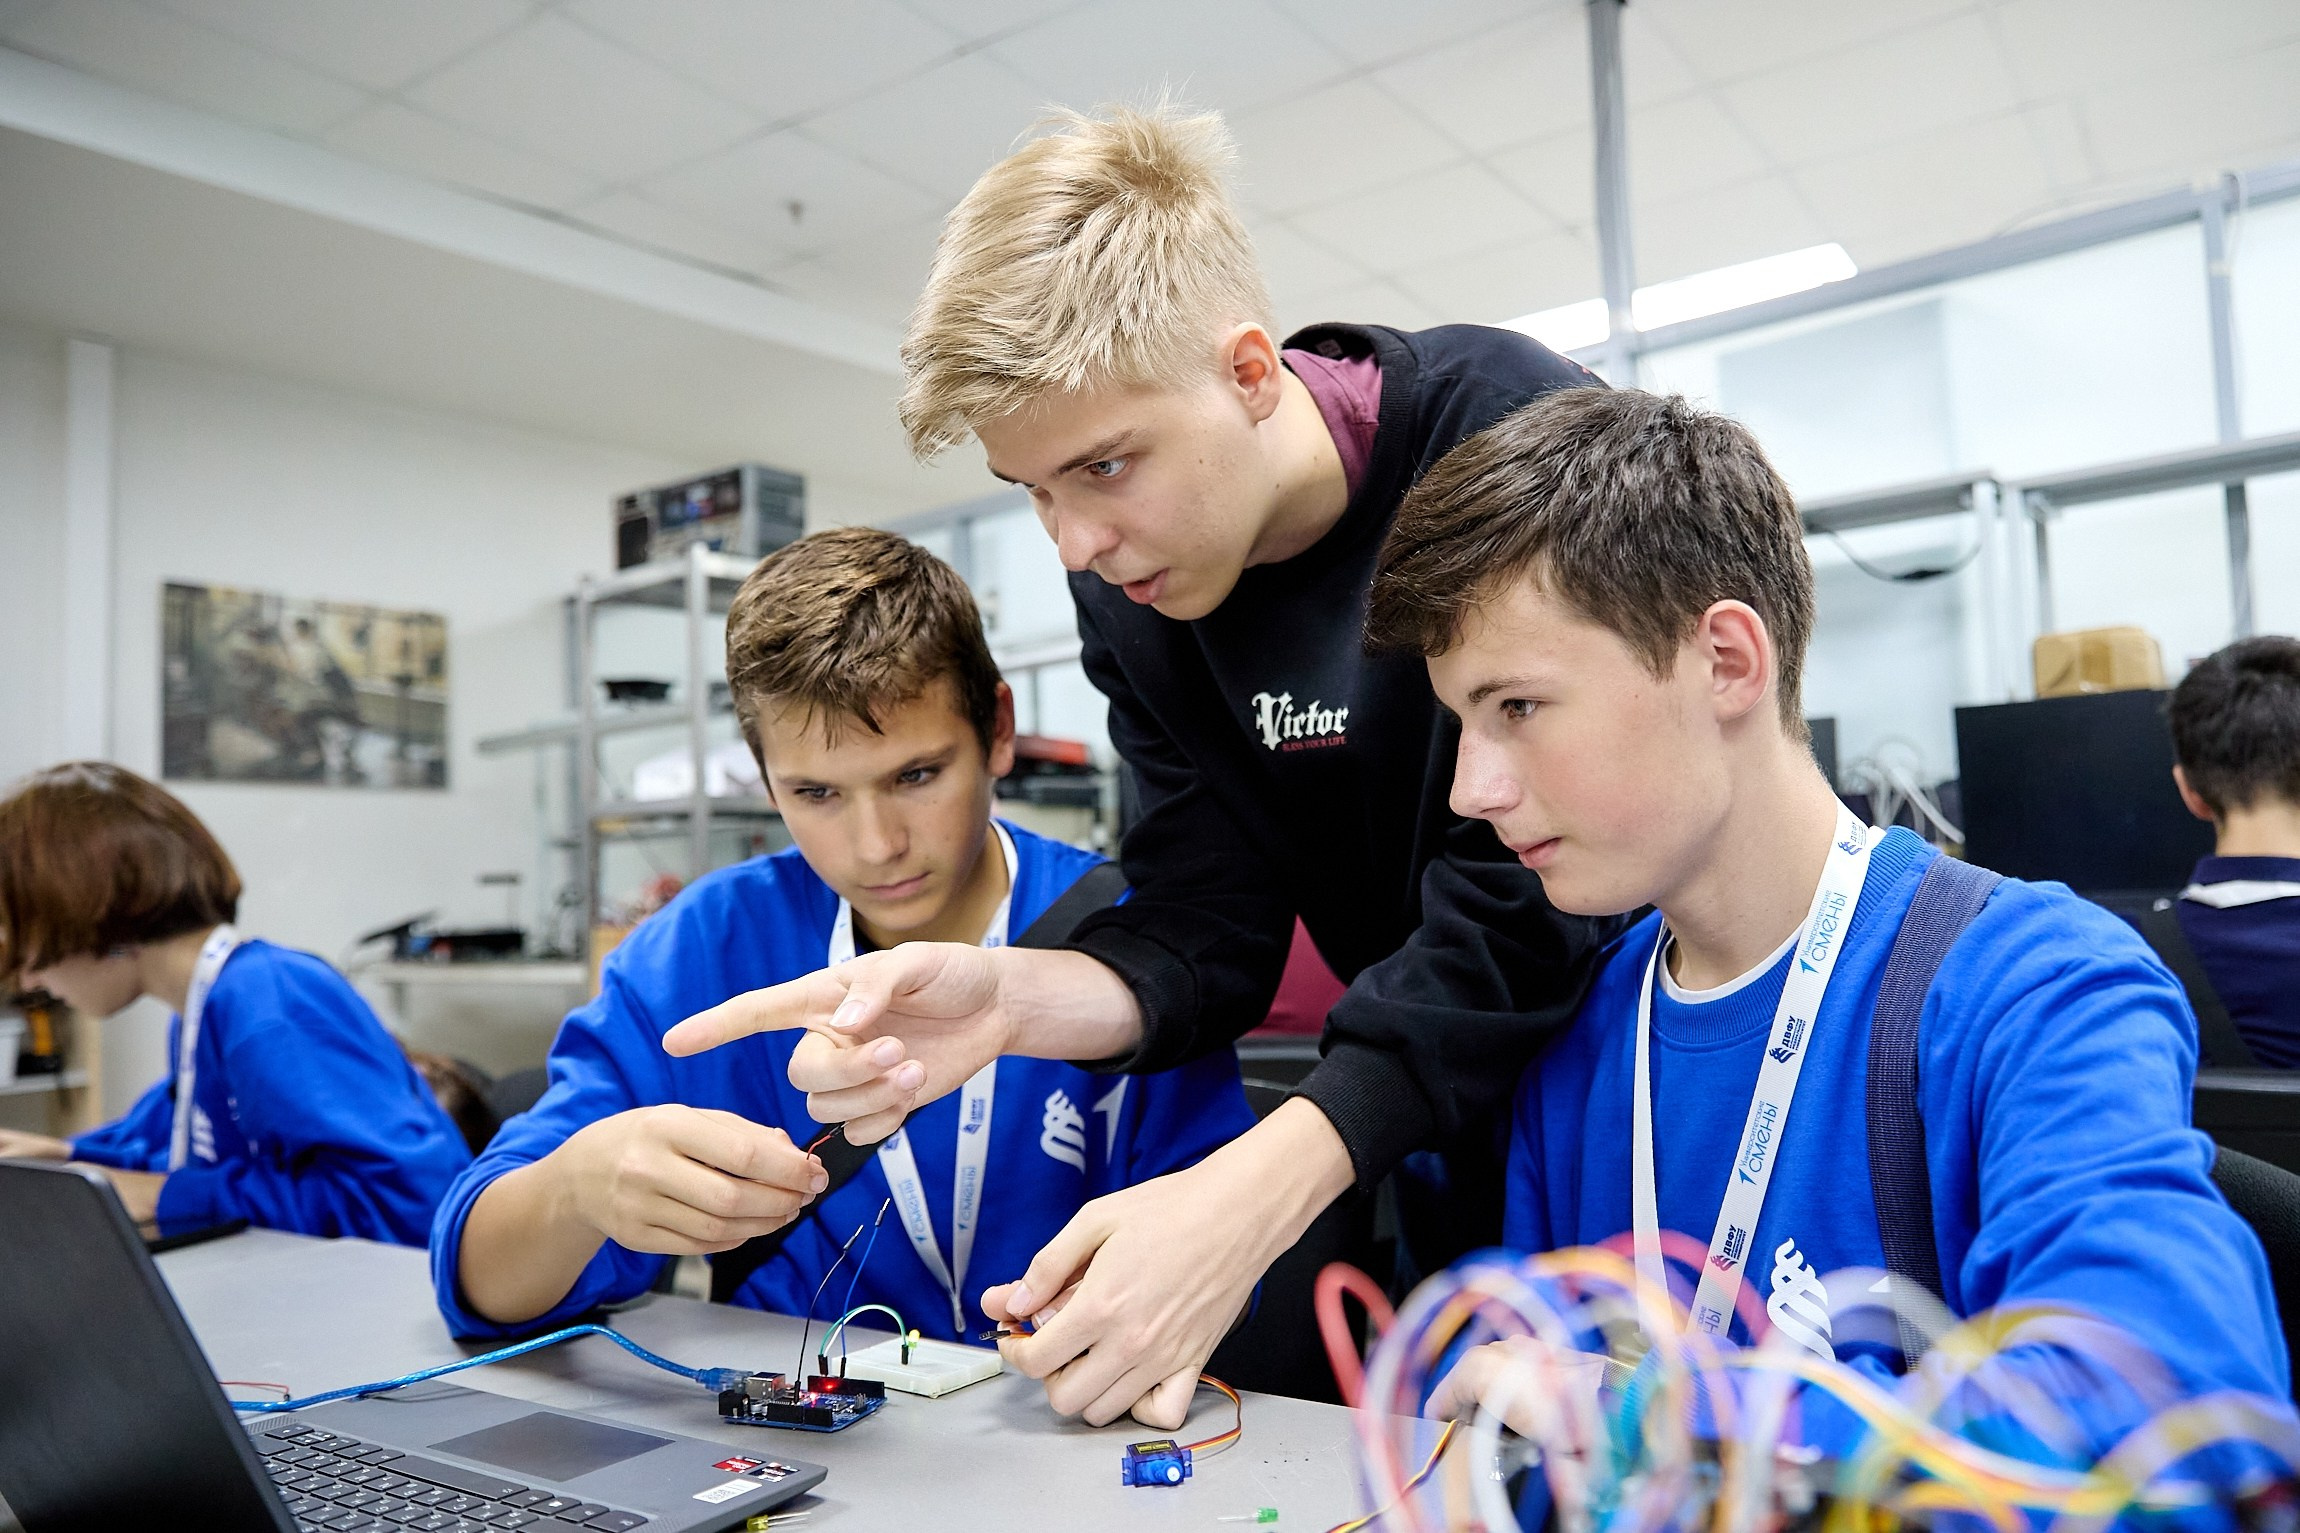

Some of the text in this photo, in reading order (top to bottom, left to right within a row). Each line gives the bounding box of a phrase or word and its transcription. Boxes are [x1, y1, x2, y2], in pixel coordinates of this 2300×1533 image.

[1251, 691, 1349, 750] Victor
[1782, 1015, 1796, 1048] ДВФУ
[1723, 1224, 1737, 1257] ДВФУ
